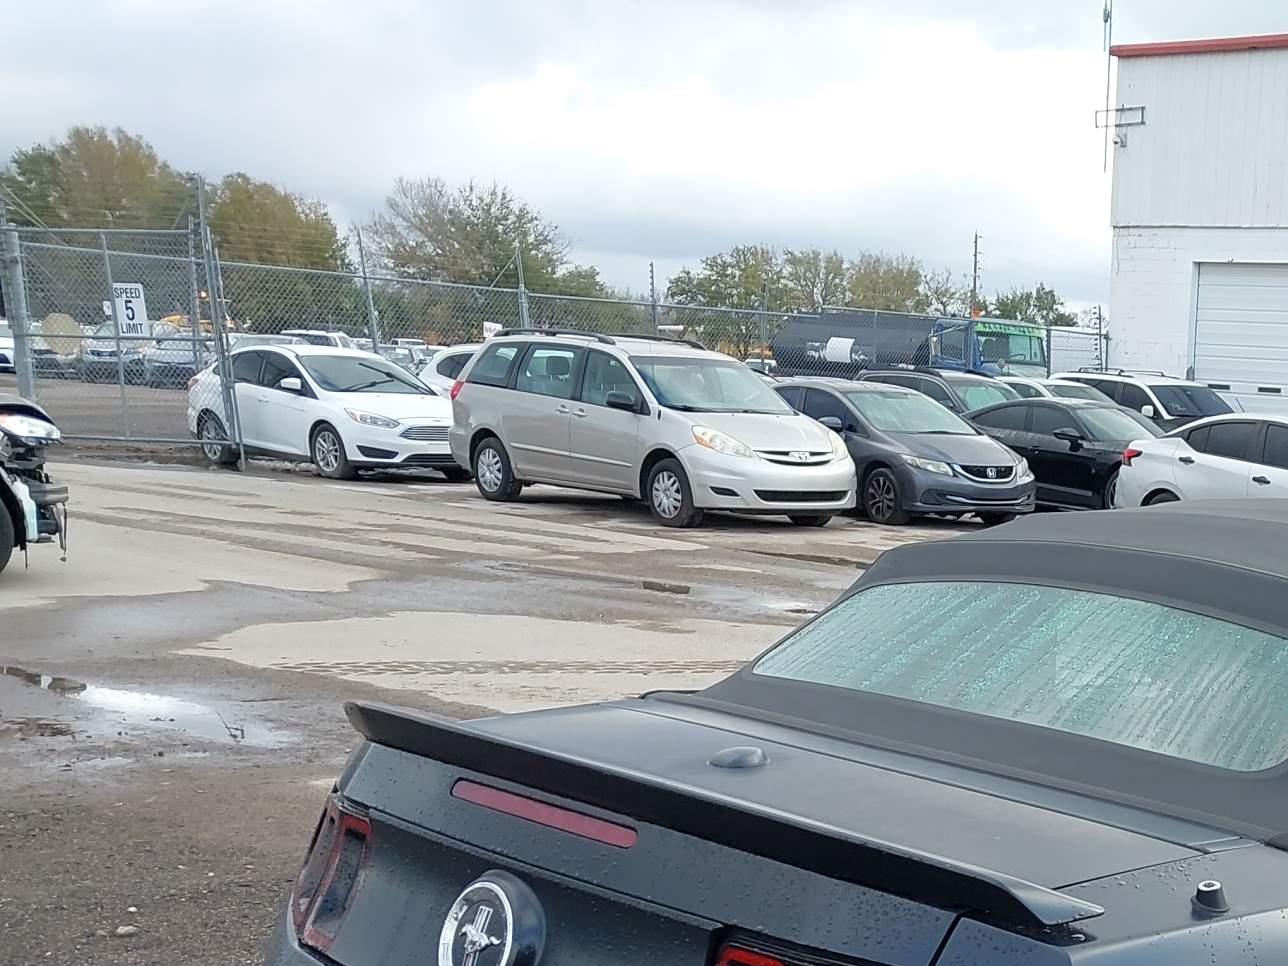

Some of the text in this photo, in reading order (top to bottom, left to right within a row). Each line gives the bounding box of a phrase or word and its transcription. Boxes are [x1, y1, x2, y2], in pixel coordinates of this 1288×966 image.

[113, 287, 141, 299] SPEED
[124, 299, 136, 321] 5
[120, 322, 144, 335] LIMIT
